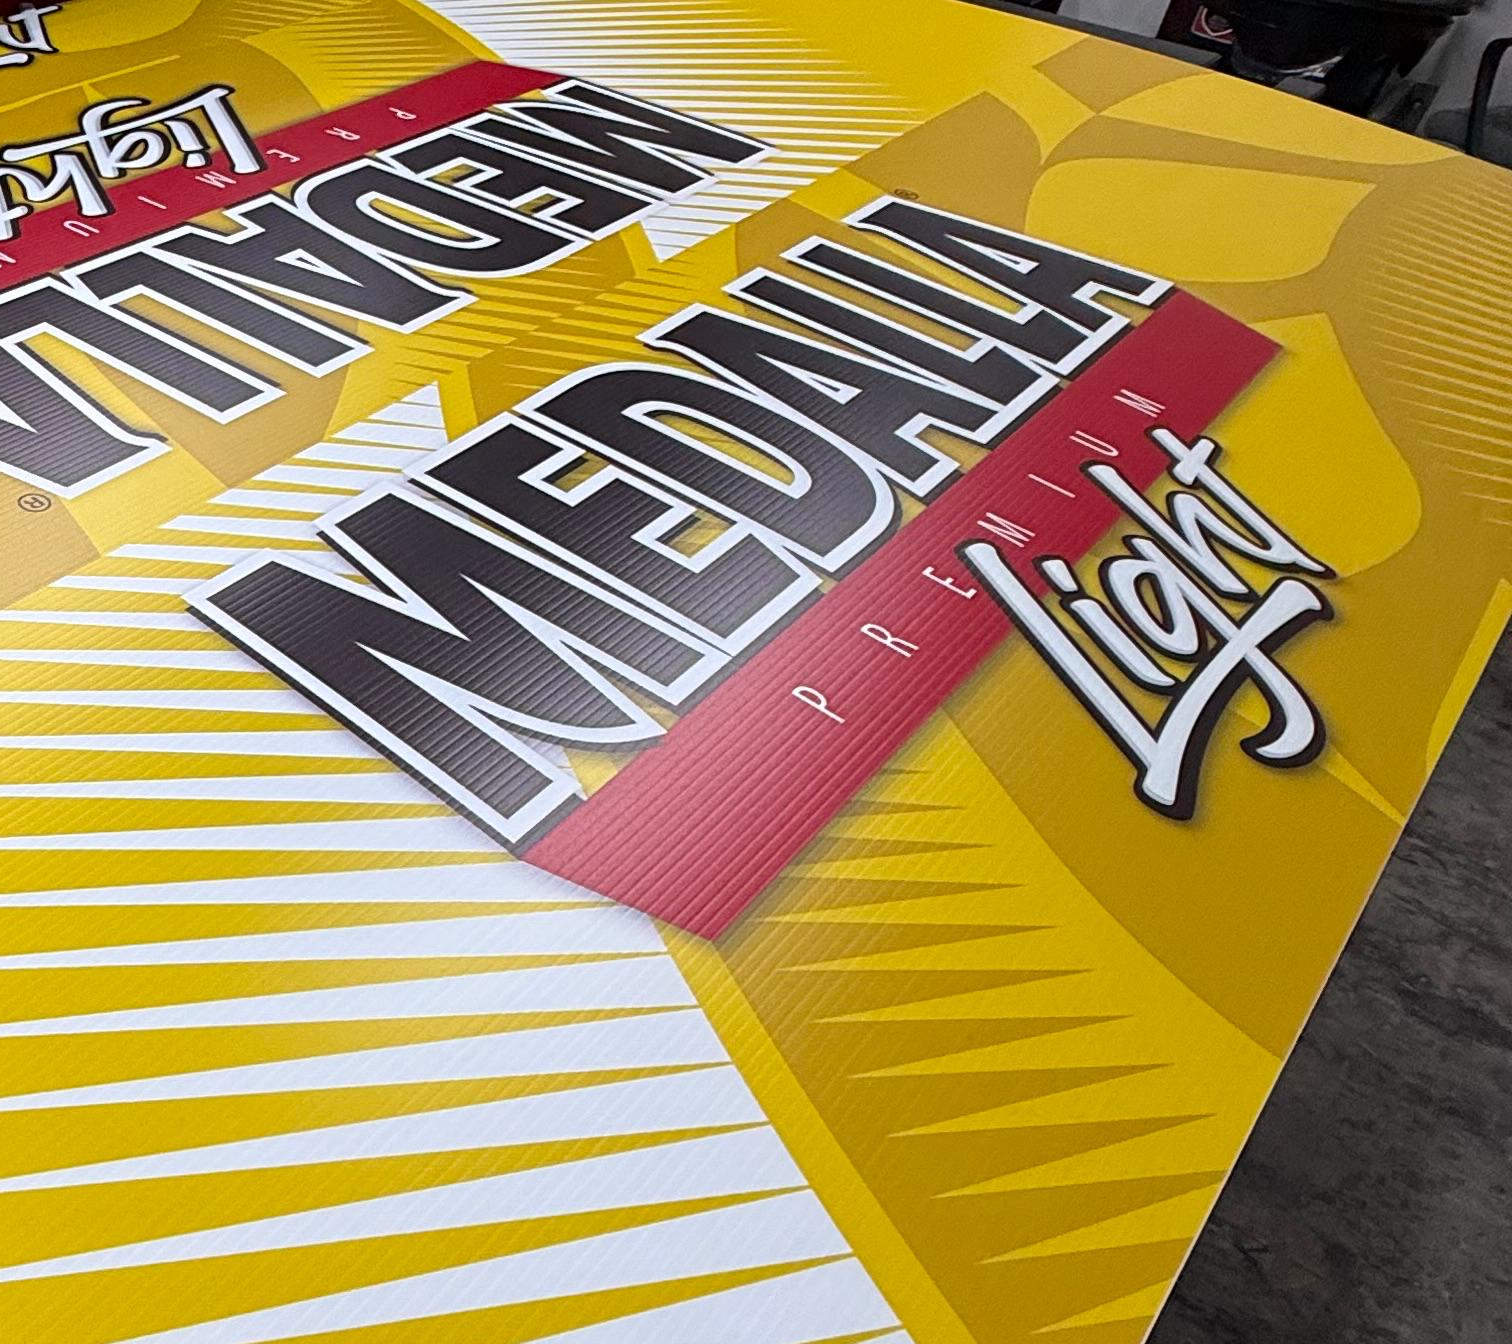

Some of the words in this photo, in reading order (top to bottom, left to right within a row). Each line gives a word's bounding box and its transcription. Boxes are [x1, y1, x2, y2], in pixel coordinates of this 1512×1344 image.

[186, 194, 1176, 852] MEDALLA
[791, 389, 1166, 724] PREMIUM
[955, 425, 1337, 821] Light
